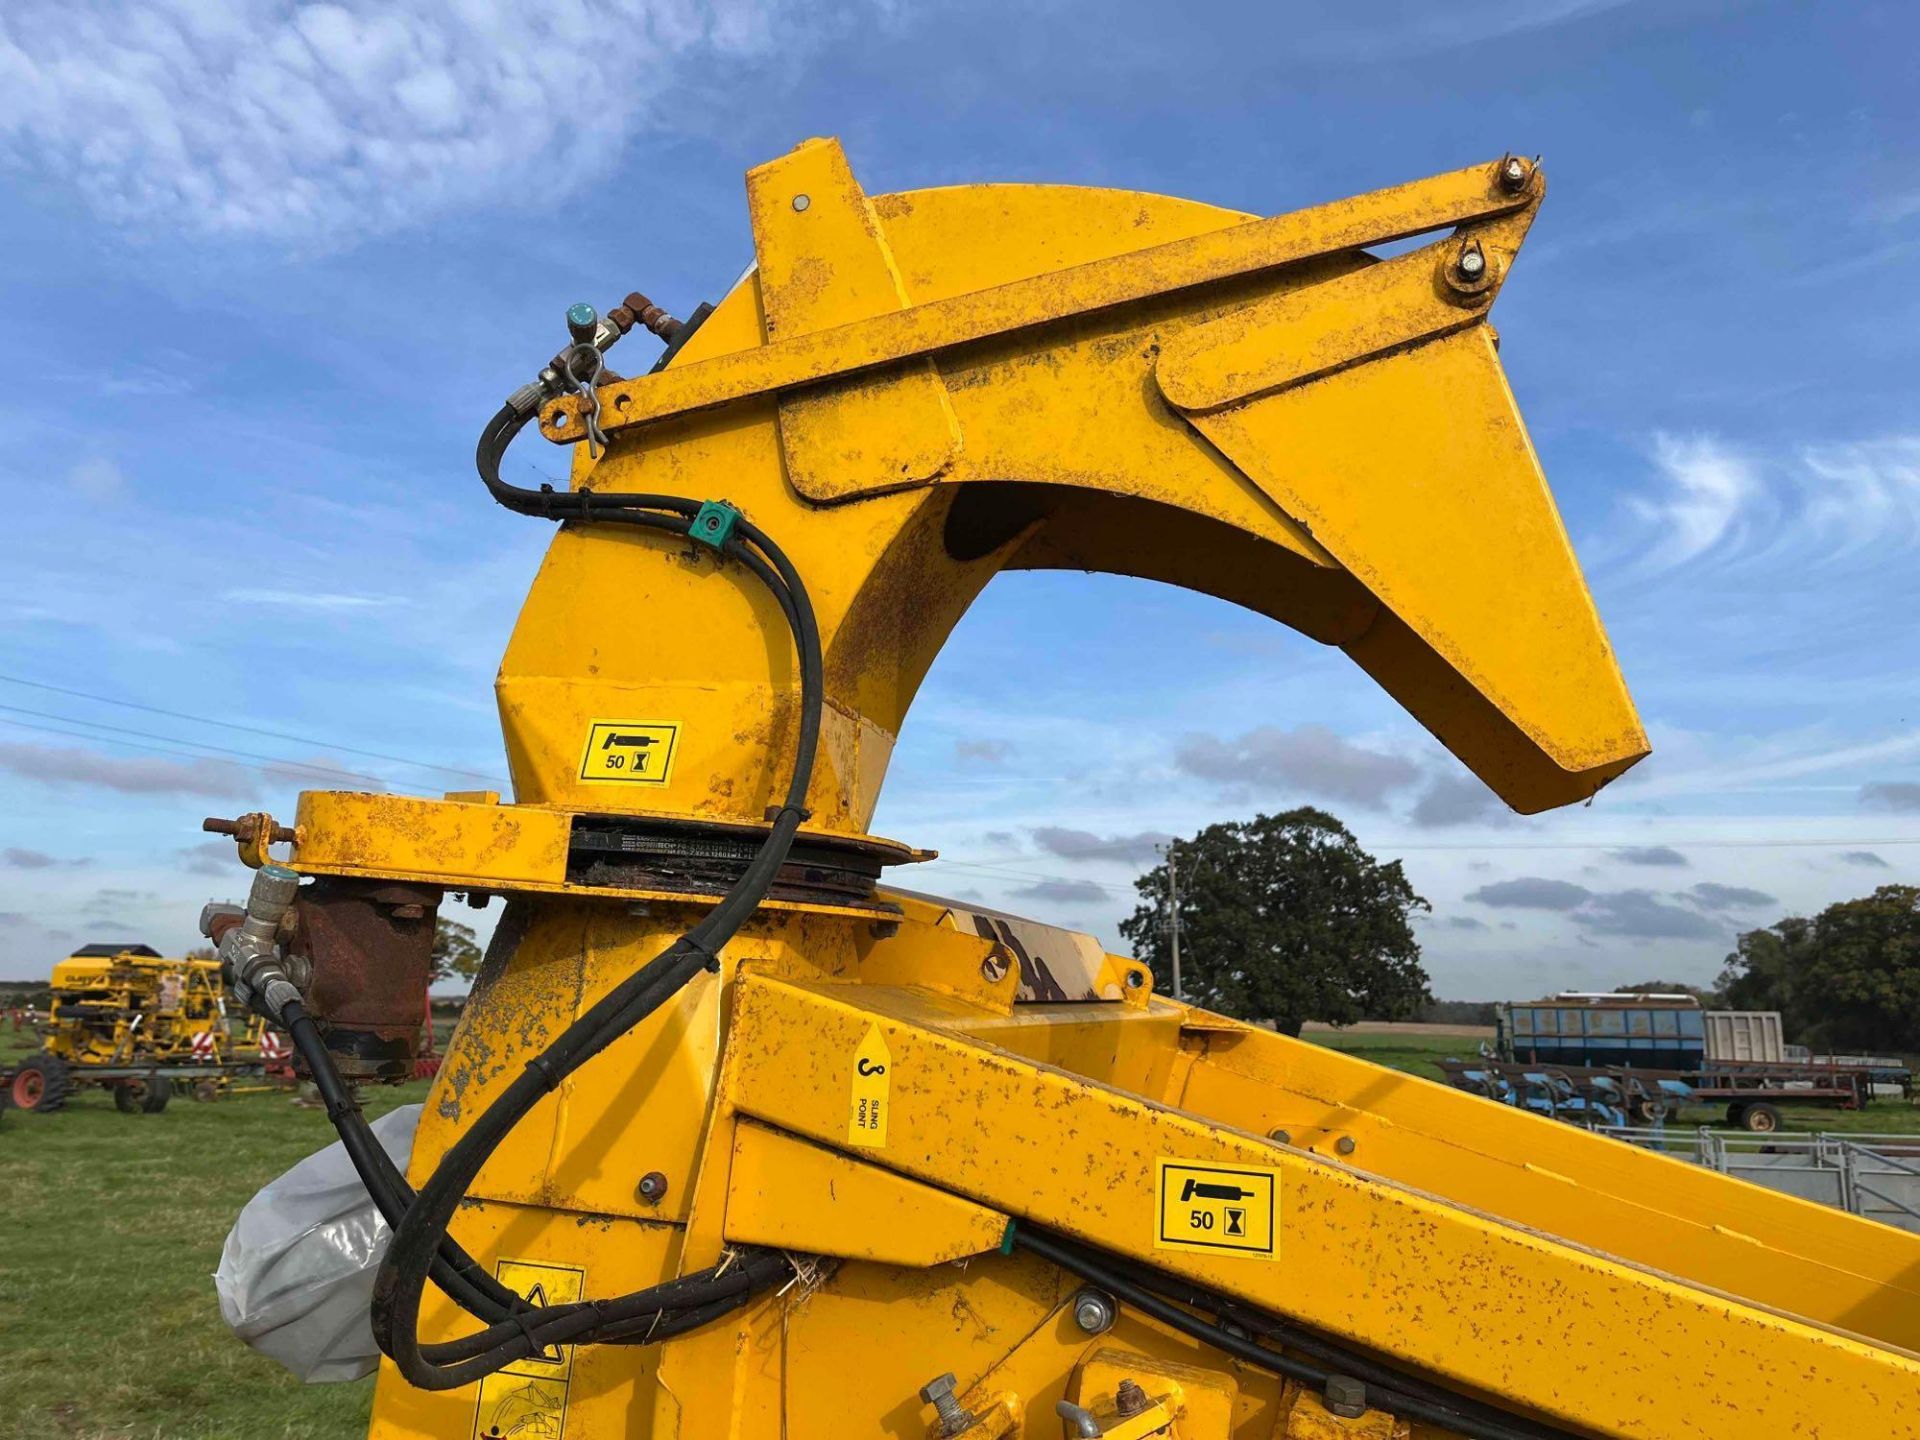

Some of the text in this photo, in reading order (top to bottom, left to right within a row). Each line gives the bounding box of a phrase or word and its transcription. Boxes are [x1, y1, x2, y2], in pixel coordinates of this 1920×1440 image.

[606, 755, 625, 769] 50
[858, 1098, 867, 1128] POINT
[870, 1100, 879, 1129] SLING
[1190, 1210, 1214, 1230] 50
